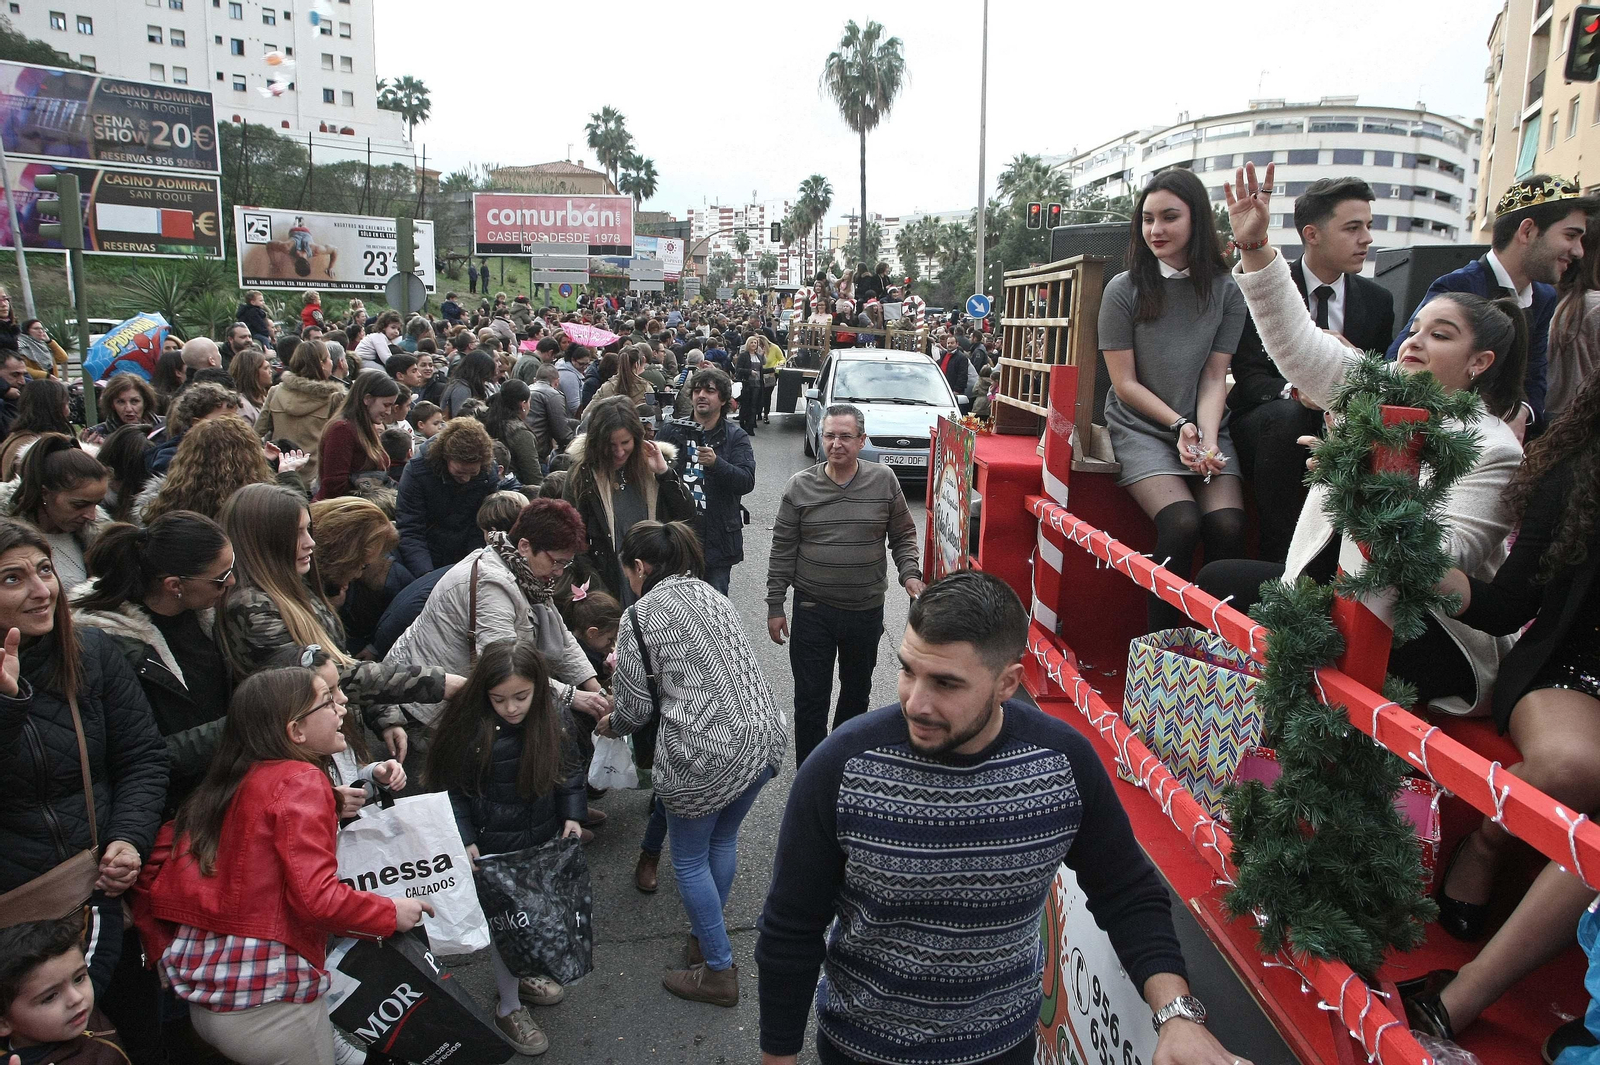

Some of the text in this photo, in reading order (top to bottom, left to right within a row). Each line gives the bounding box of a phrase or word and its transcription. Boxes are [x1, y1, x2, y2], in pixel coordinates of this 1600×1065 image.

[101, 83, 211, 106] CASINO ADMIRAL
[126, 100, 190, 115] SAN ROQUE
[93, 114, 149, 131] CENA &
[94, 127, 150, 144] SHOW
[152, 120, 215, 151] 20€
[100, 151, 153, 164] RESERVAS
[155, 156, 174, 166] 956
[104, 174, 214, 192] CASINO ADMIRAL
[129, 190, 192, 203] SAN ROQUE
[487, 200, 614, 228] comurbán
[487, 231, 621, 244] CASEROS DESDE 1978
[103, 241, 156, 253] RESERVAS
[884, 455, 905, 465] 9542
[405, 877, 455, 898] CALZADOS
[353, 982, 424, 1045] MOR
[1092, 974, 1120, 1048] 956
[421, 1041, 450, 1065] marcas
